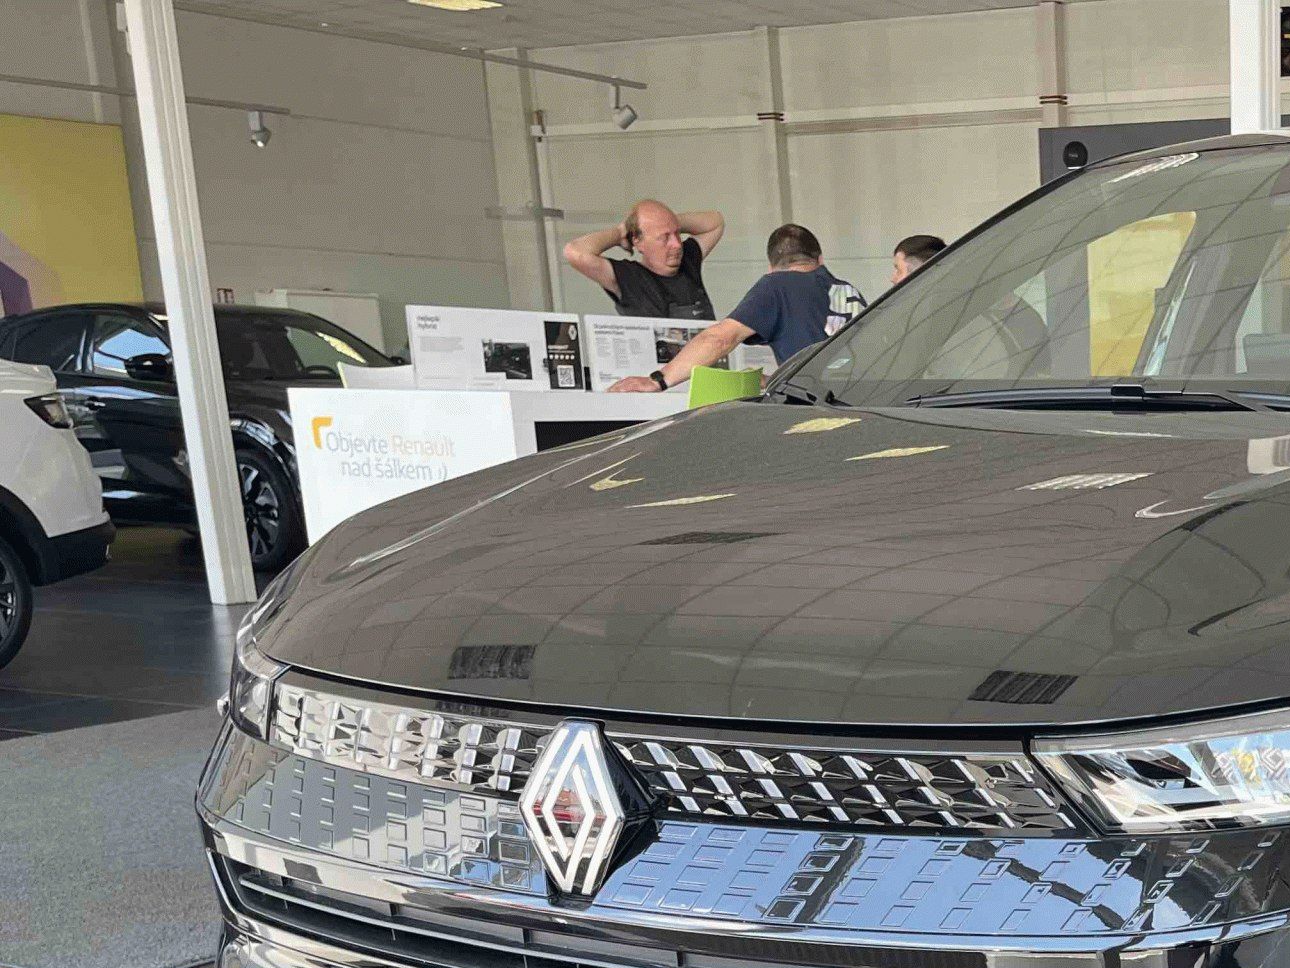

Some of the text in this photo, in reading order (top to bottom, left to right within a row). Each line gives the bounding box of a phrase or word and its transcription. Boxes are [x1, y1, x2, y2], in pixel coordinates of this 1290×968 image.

[326, 431, 456, 458] Objevte Renault
[340, 459, 371, 477] nad
[375, 457, 432, 481] šálkem
